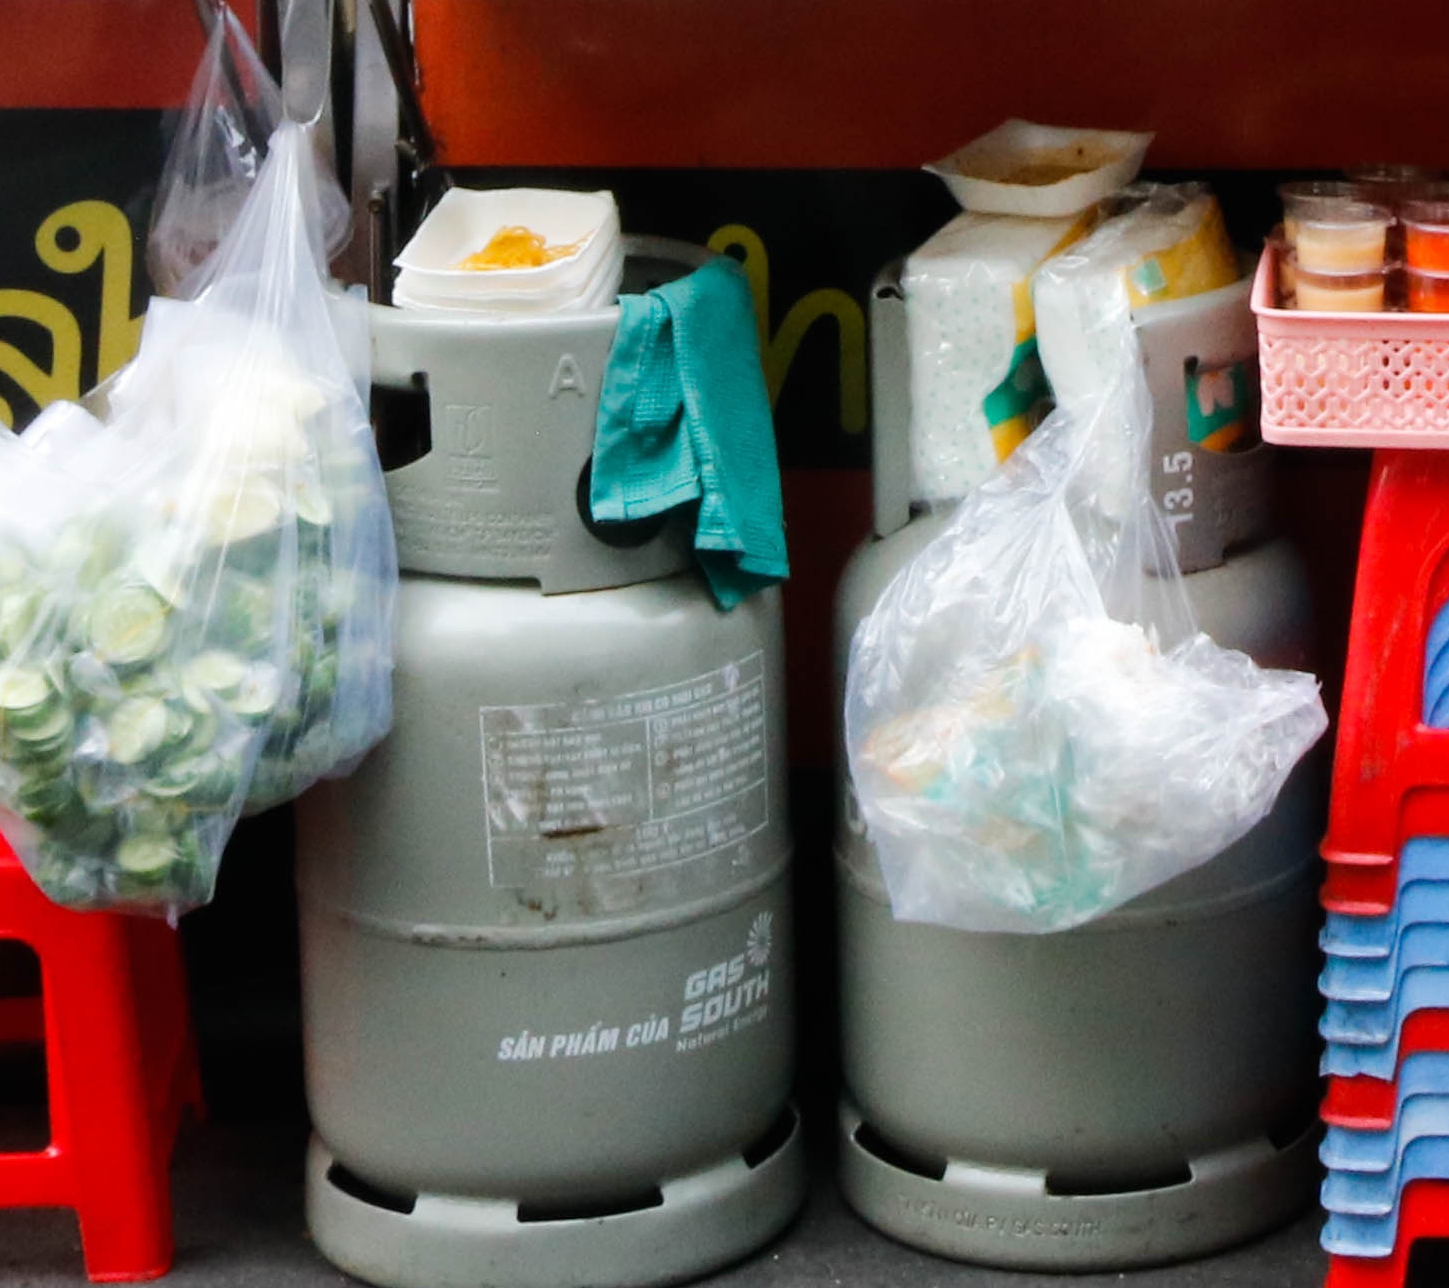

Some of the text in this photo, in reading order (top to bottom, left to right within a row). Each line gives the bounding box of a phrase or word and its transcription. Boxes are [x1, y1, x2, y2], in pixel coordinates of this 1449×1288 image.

[548, 352, 587, 400] A
[679, 967, 770, 1034] SOUTH
[683, 952, 748, 1002] GAS
[497, 1029, 547, 1061] SẢN
[625, 1014, 671, 1048] CỦA
